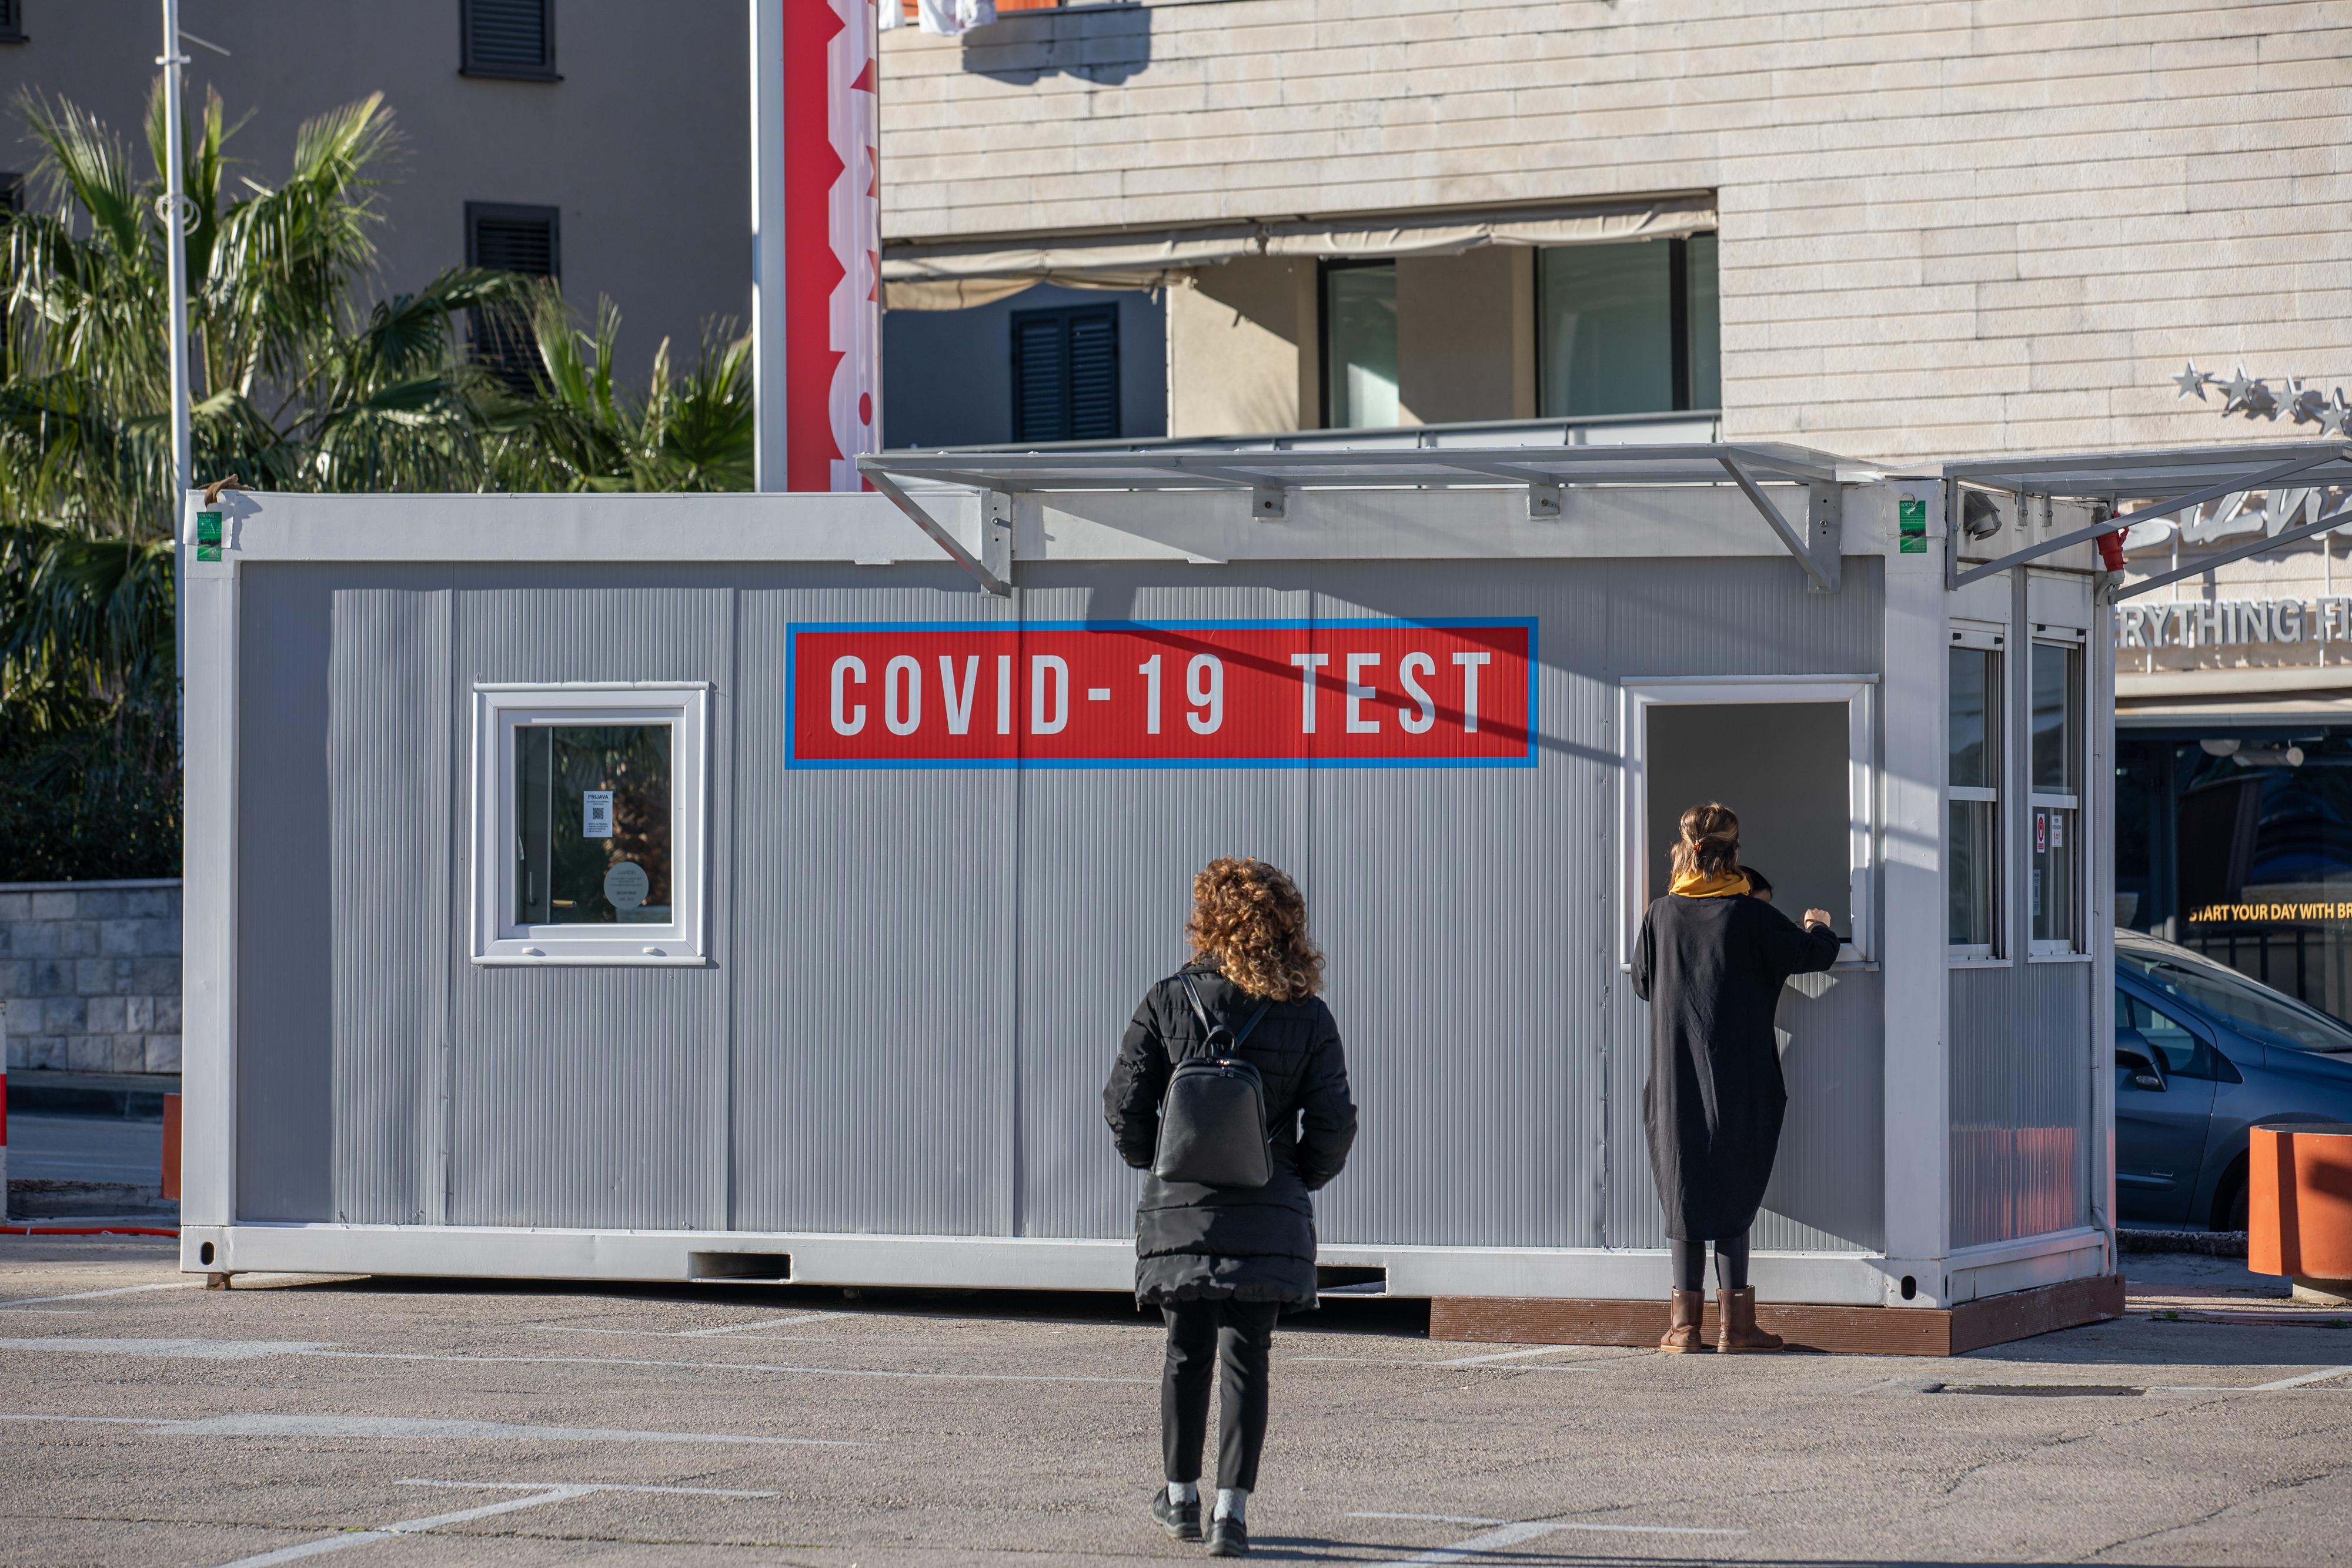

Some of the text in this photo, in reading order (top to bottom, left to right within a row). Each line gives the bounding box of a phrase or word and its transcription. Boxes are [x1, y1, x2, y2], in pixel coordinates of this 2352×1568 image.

[2117, 597, 2350, 648] RYTHING FI
[830, 651, 1491, 736] COVID-19 TEST
[2189, 904, 2230, 922] START
[2231, 904, 2268, 921] YOUR
[2270, 903, 2298, 920] DAY
[2299, 902, 2334, 920] WITH
